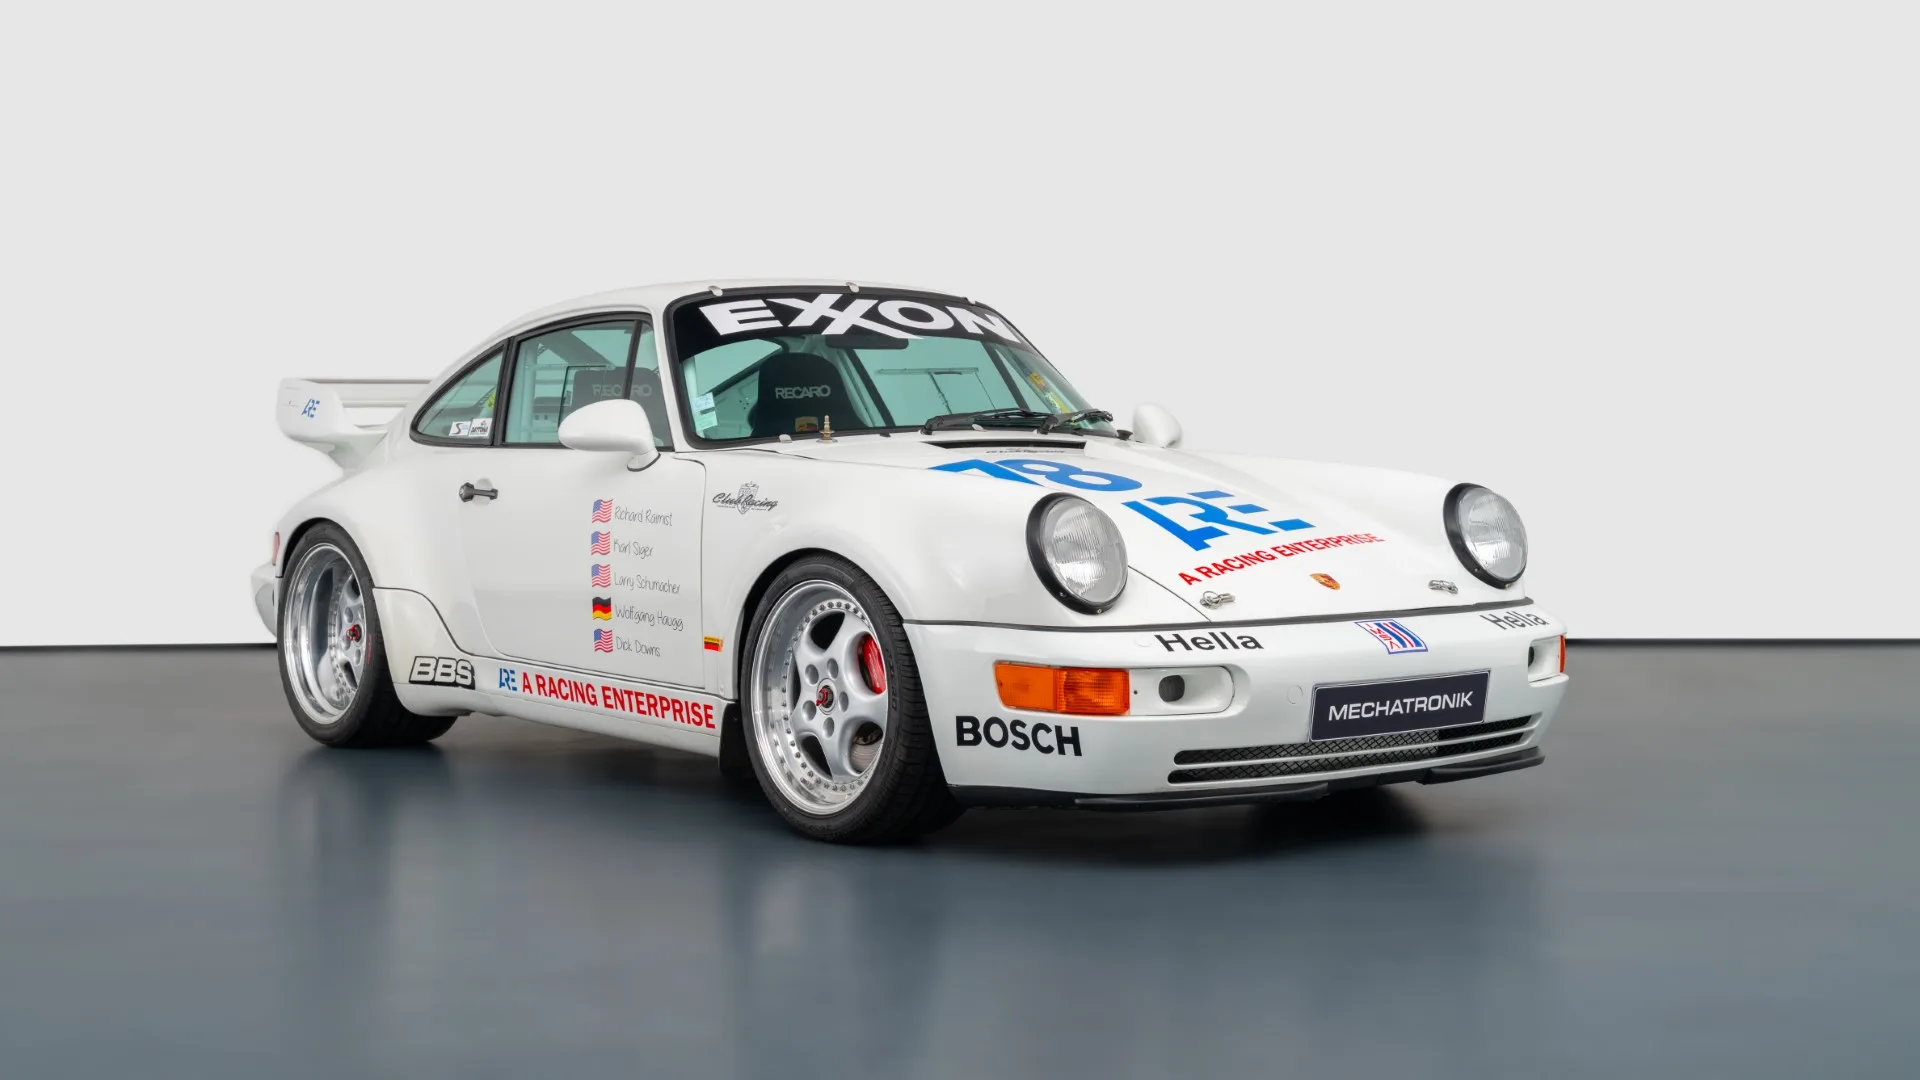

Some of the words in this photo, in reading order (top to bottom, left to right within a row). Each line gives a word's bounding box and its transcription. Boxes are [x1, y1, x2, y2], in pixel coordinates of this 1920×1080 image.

[699, 294, 1021, 343] EXXON
[592, 384, 652, 397] RECRO
[775, 384, 831, 399] RECARO
[712, 492, 743, 505] Club
[741, 494, 778, 511] Racing
[614, 505, 643, 522] Richard
[645, 508, 673, 527] Raimist
[1121, 490, 1317, 552] ARE
[613, 538, 631, 555] Karl
[1178, 572, 1202, 586] A
[1196, 550, 1276, 579] RACING
[1273, 533, 1385, 558] ENTERPRISE
[613, 572, 635, 591] Larry
[636, 574, 681, 594] Schumacher
[614, 604, 656, 627] Wolfgang
[657, 610, 684, 632] Haugg
[1479, 611, 1550, 630] Hella
[616, 636, 632, 652] Dick
[634, 640, 661, 657] Downs
[1154, 631, 1264, 652] Hella
[409, 656, 475, 690] BBS
[522, 672, 533, 695] A
[535, 674, 598, 707] RACING
[601, 685, 716, 729] ENTERPRISE
[1328, 691, 1474, 722] MECHATRONIK
[956, 715, 1083, 757] BOSCH
